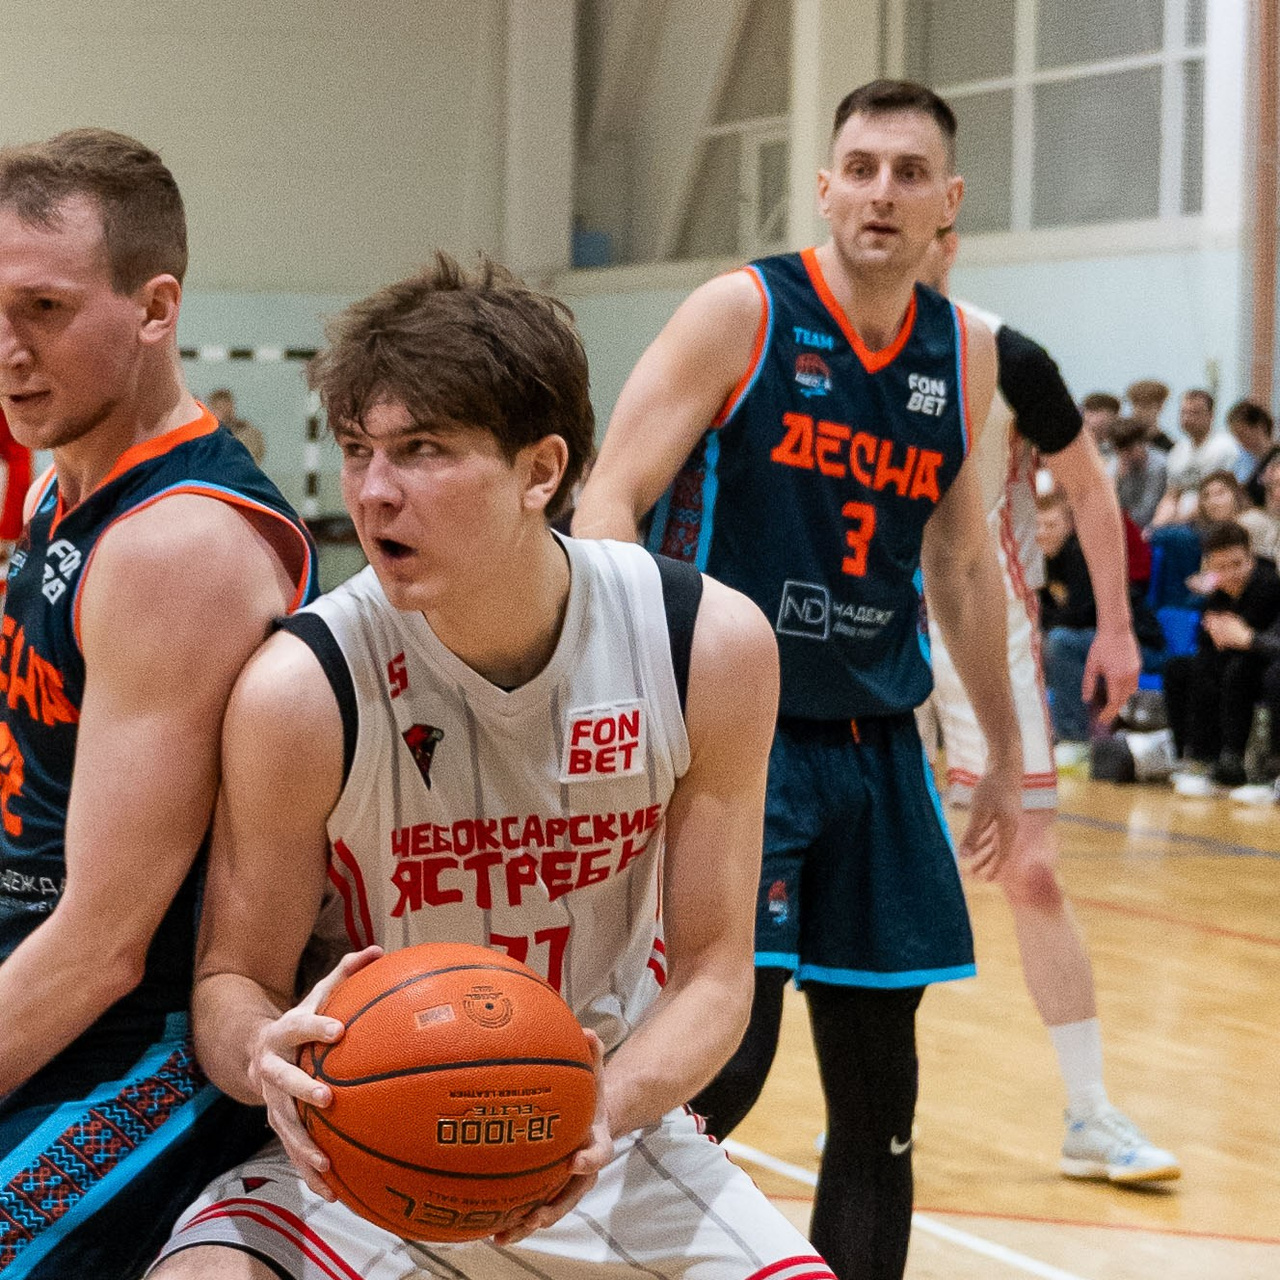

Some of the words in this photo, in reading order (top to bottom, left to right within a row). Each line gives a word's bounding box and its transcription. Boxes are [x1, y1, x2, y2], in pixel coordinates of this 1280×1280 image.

[792, 325, 835, 351] TEAM
[907, 372, 947, 397] FON
[905, 391, 947, 417] BET
[770, 411, 944, 503] ДЕСНА
[841, 501, 876, 578] 3
[571, 710, 640, 746] FON
[568, 741, 639, 775] BET
[390, 803, 662, 857] ЧЕБОКСАРСКИЕ
[473, 1104, 534, 1116] ELITE
[436, 1114, 561, 1145] JB-1000
